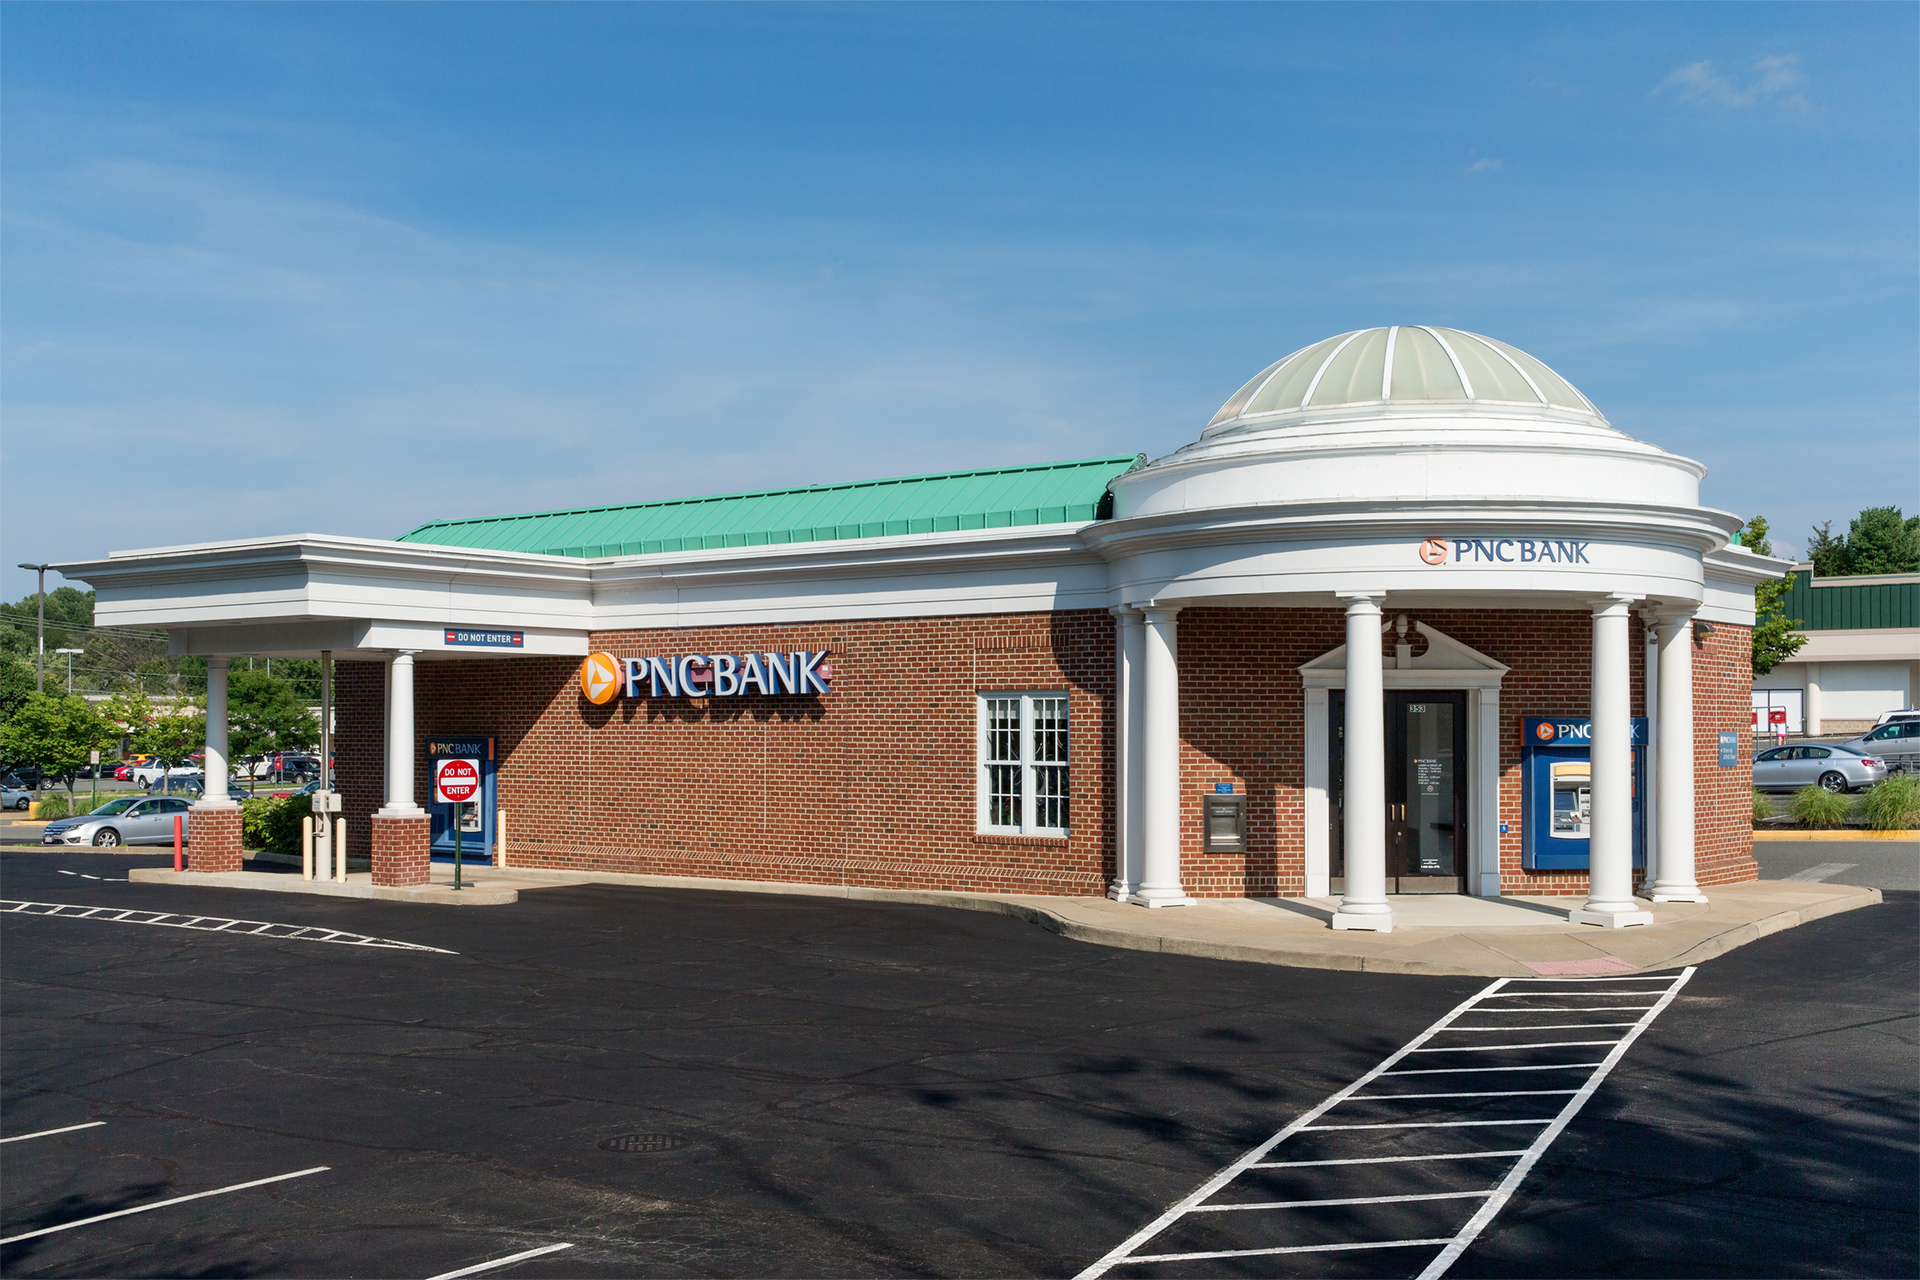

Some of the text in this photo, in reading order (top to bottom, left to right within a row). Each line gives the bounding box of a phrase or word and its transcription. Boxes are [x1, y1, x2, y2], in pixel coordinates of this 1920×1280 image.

[458, 633, 511, 644] DO NOT ENTER
[1410, 704, 1425, 713] 353
[444, 767, 472, 776] DO NOT
[446, 786, 470, 795] ENTER
